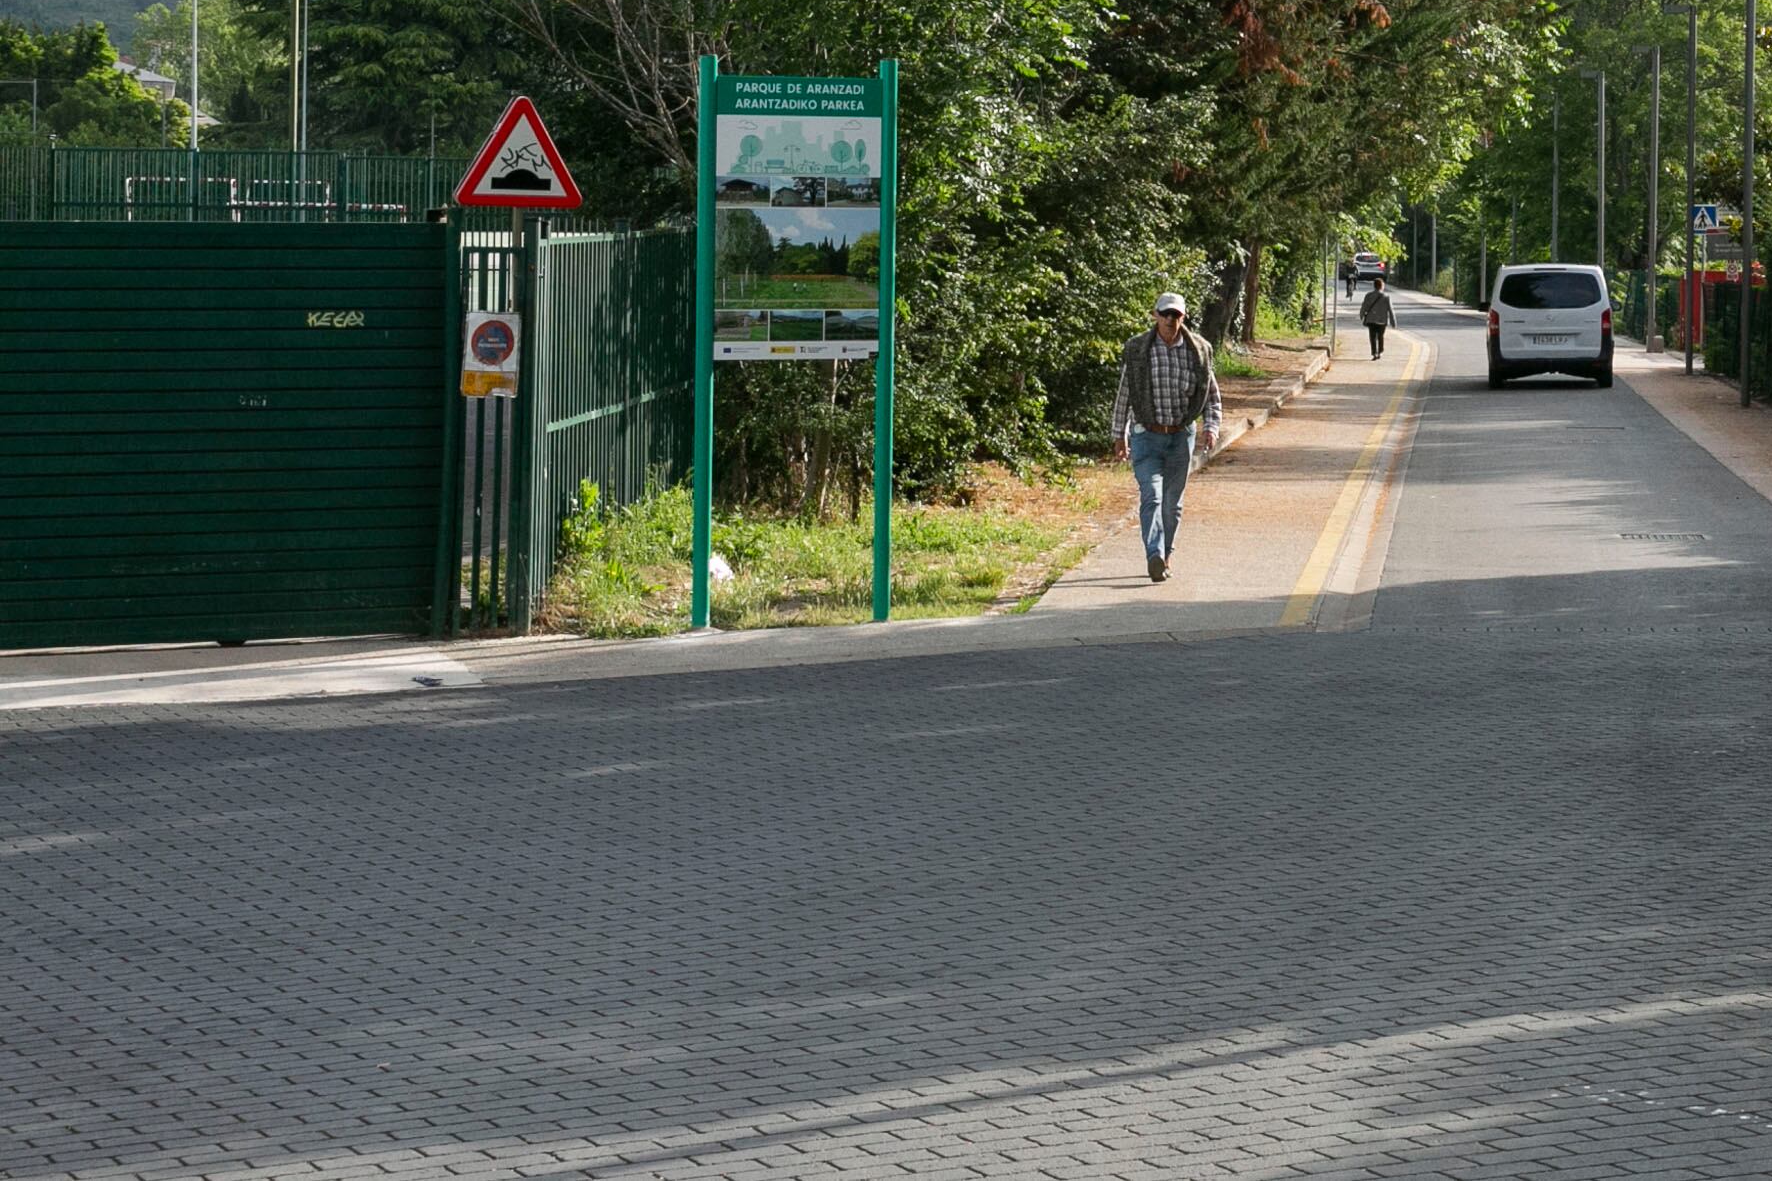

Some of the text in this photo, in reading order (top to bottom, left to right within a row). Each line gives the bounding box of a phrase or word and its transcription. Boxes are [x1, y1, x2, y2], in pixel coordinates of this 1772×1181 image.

[736, 82, 865, 95] PARQUE DE ARANZADI
[735, 98, 865, 111] ARANTZADIKO PARKEA
